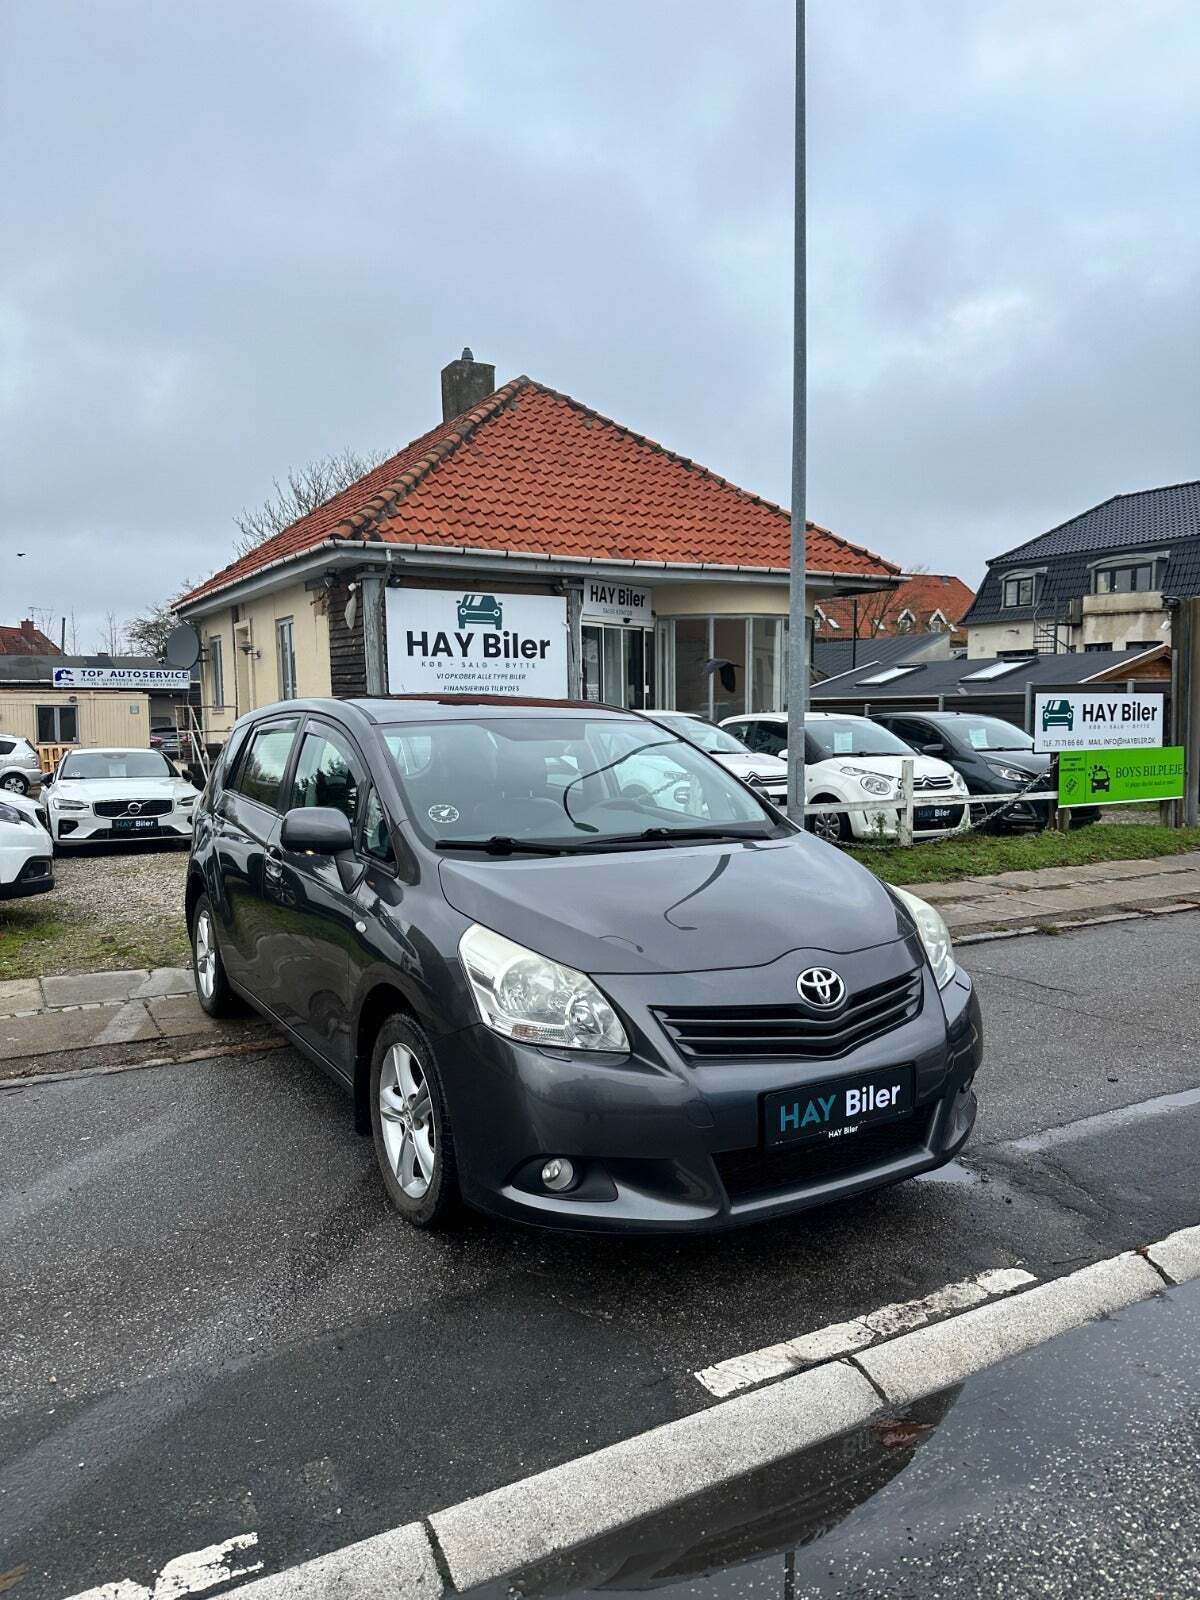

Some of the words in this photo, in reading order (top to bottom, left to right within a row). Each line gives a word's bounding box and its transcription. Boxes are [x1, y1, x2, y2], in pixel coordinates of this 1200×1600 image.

[591, 585, 615, 604] HAY
[618, 587, 645, 608] Biler
[406, 631, 475, 658] HAY
[483, 631, 551, 659] Biler
[110, 670, 188, 679] AUTOSERVICE
[1082, 703, 1118, 722] HAY
[1121, 701, 1157, 722] Biler
[1115, 767, 1142, 778] BOYS
[1143, 763, 1183, 777] BILPLEJE
[780, 1094, 836, 1132] HAY
[845, 1085, 901, 1117] Biler
[828, 1127, 842, 1138] HAY
[843, 1125, 858, 1135] Biler
